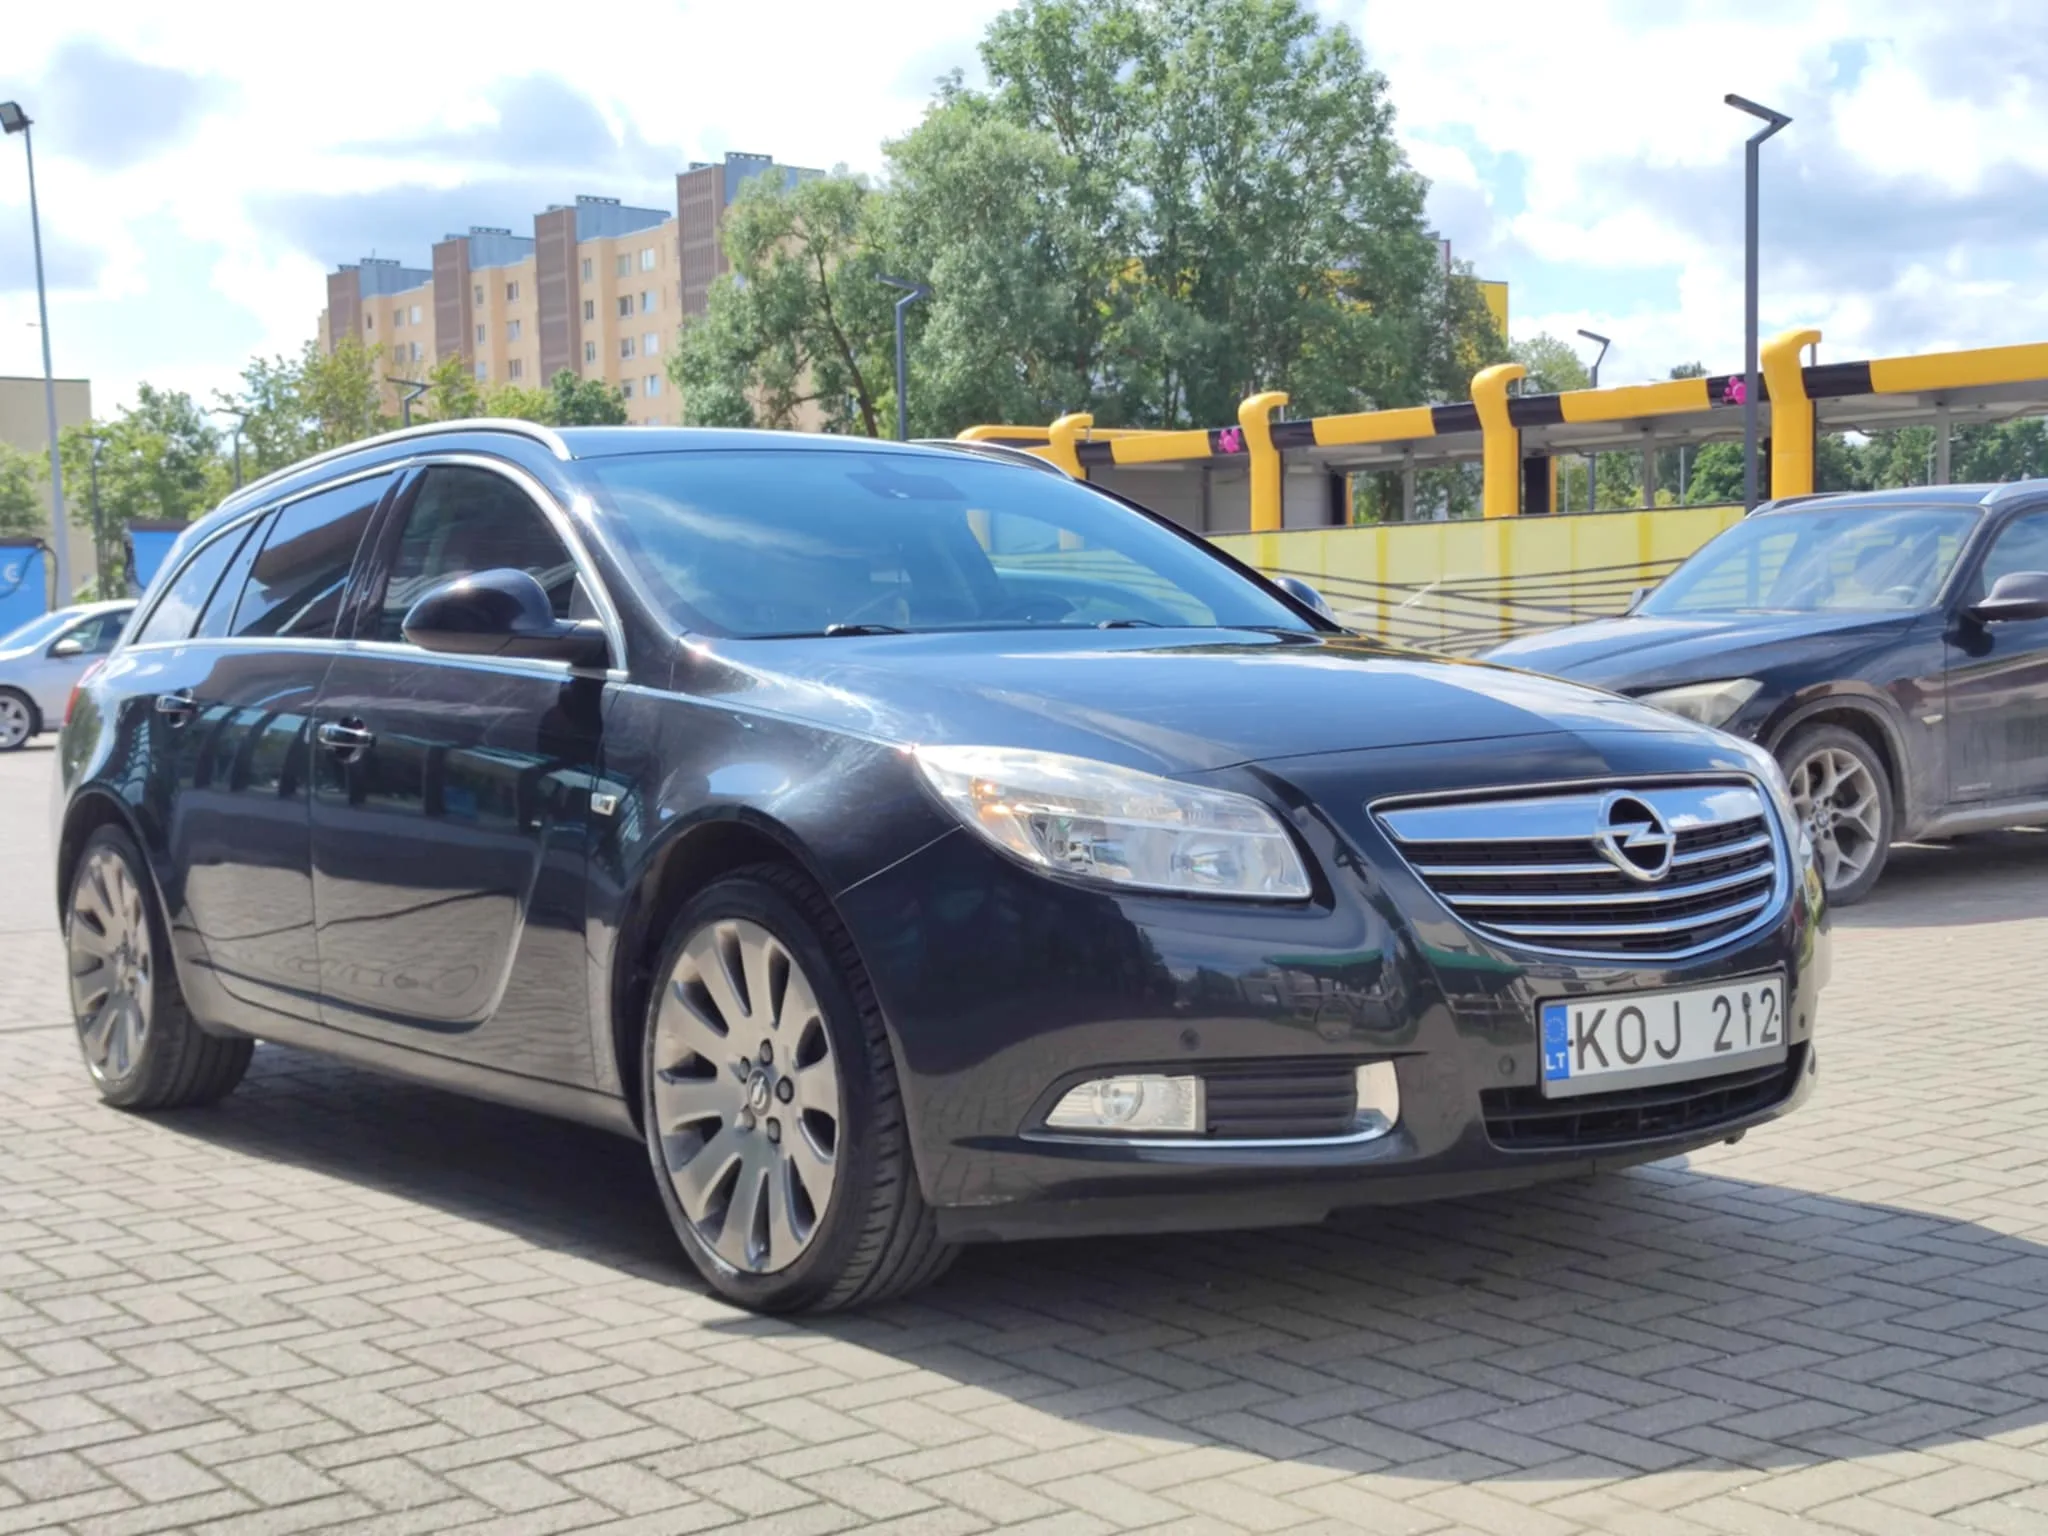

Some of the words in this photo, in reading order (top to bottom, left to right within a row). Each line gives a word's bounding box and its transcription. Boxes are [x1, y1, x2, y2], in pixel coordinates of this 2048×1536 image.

[1575, 1000, 1681, 1070] KOJ
[1712, 987, 1777, 1052] 212
[1545, 1052, 1566, 1071] LT
